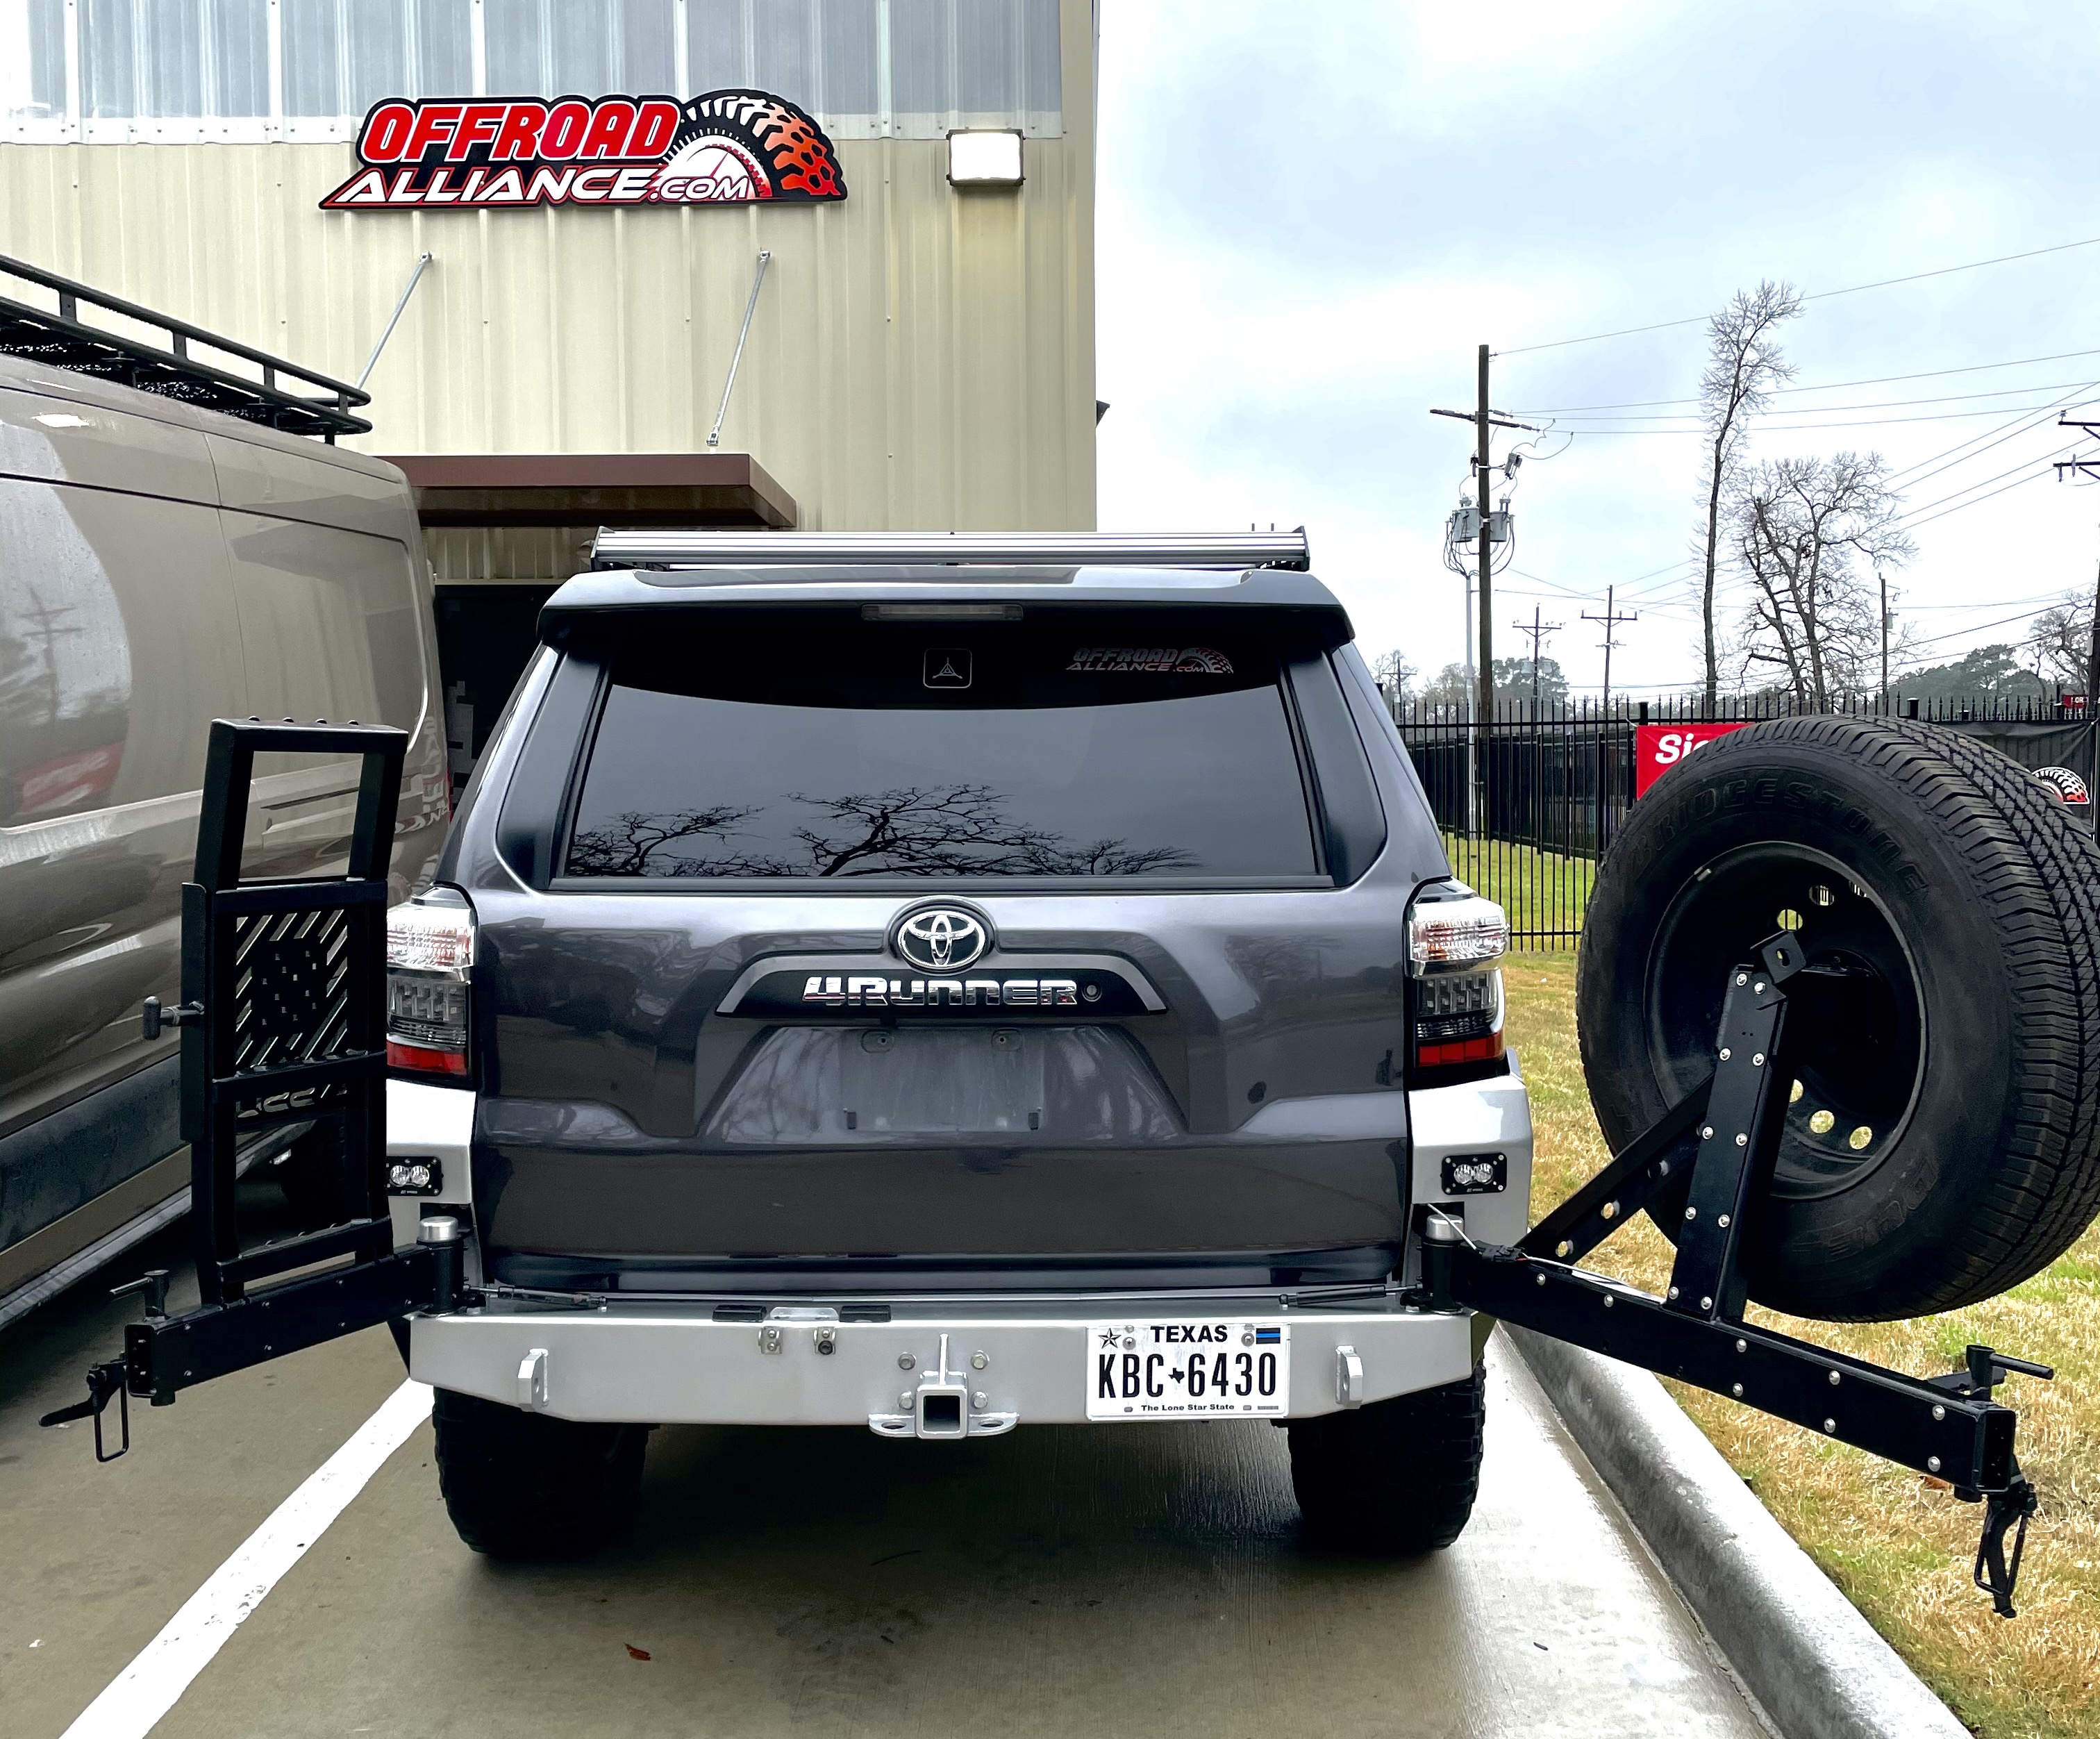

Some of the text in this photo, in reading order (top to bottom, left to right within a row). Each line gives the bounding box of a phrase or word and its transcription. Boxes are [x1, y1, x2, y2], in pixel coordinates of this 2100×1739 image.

[361, 101, 681, 163] OFFROAD
[1073, 647, 1178, 663] OFFROAD
[1636, 777, 1930, 893] BRIDGESTONE
[1150, 1324, 1228, 1343] TEXAS
[1099, 1352, 1276, 1399] KBC 6430
